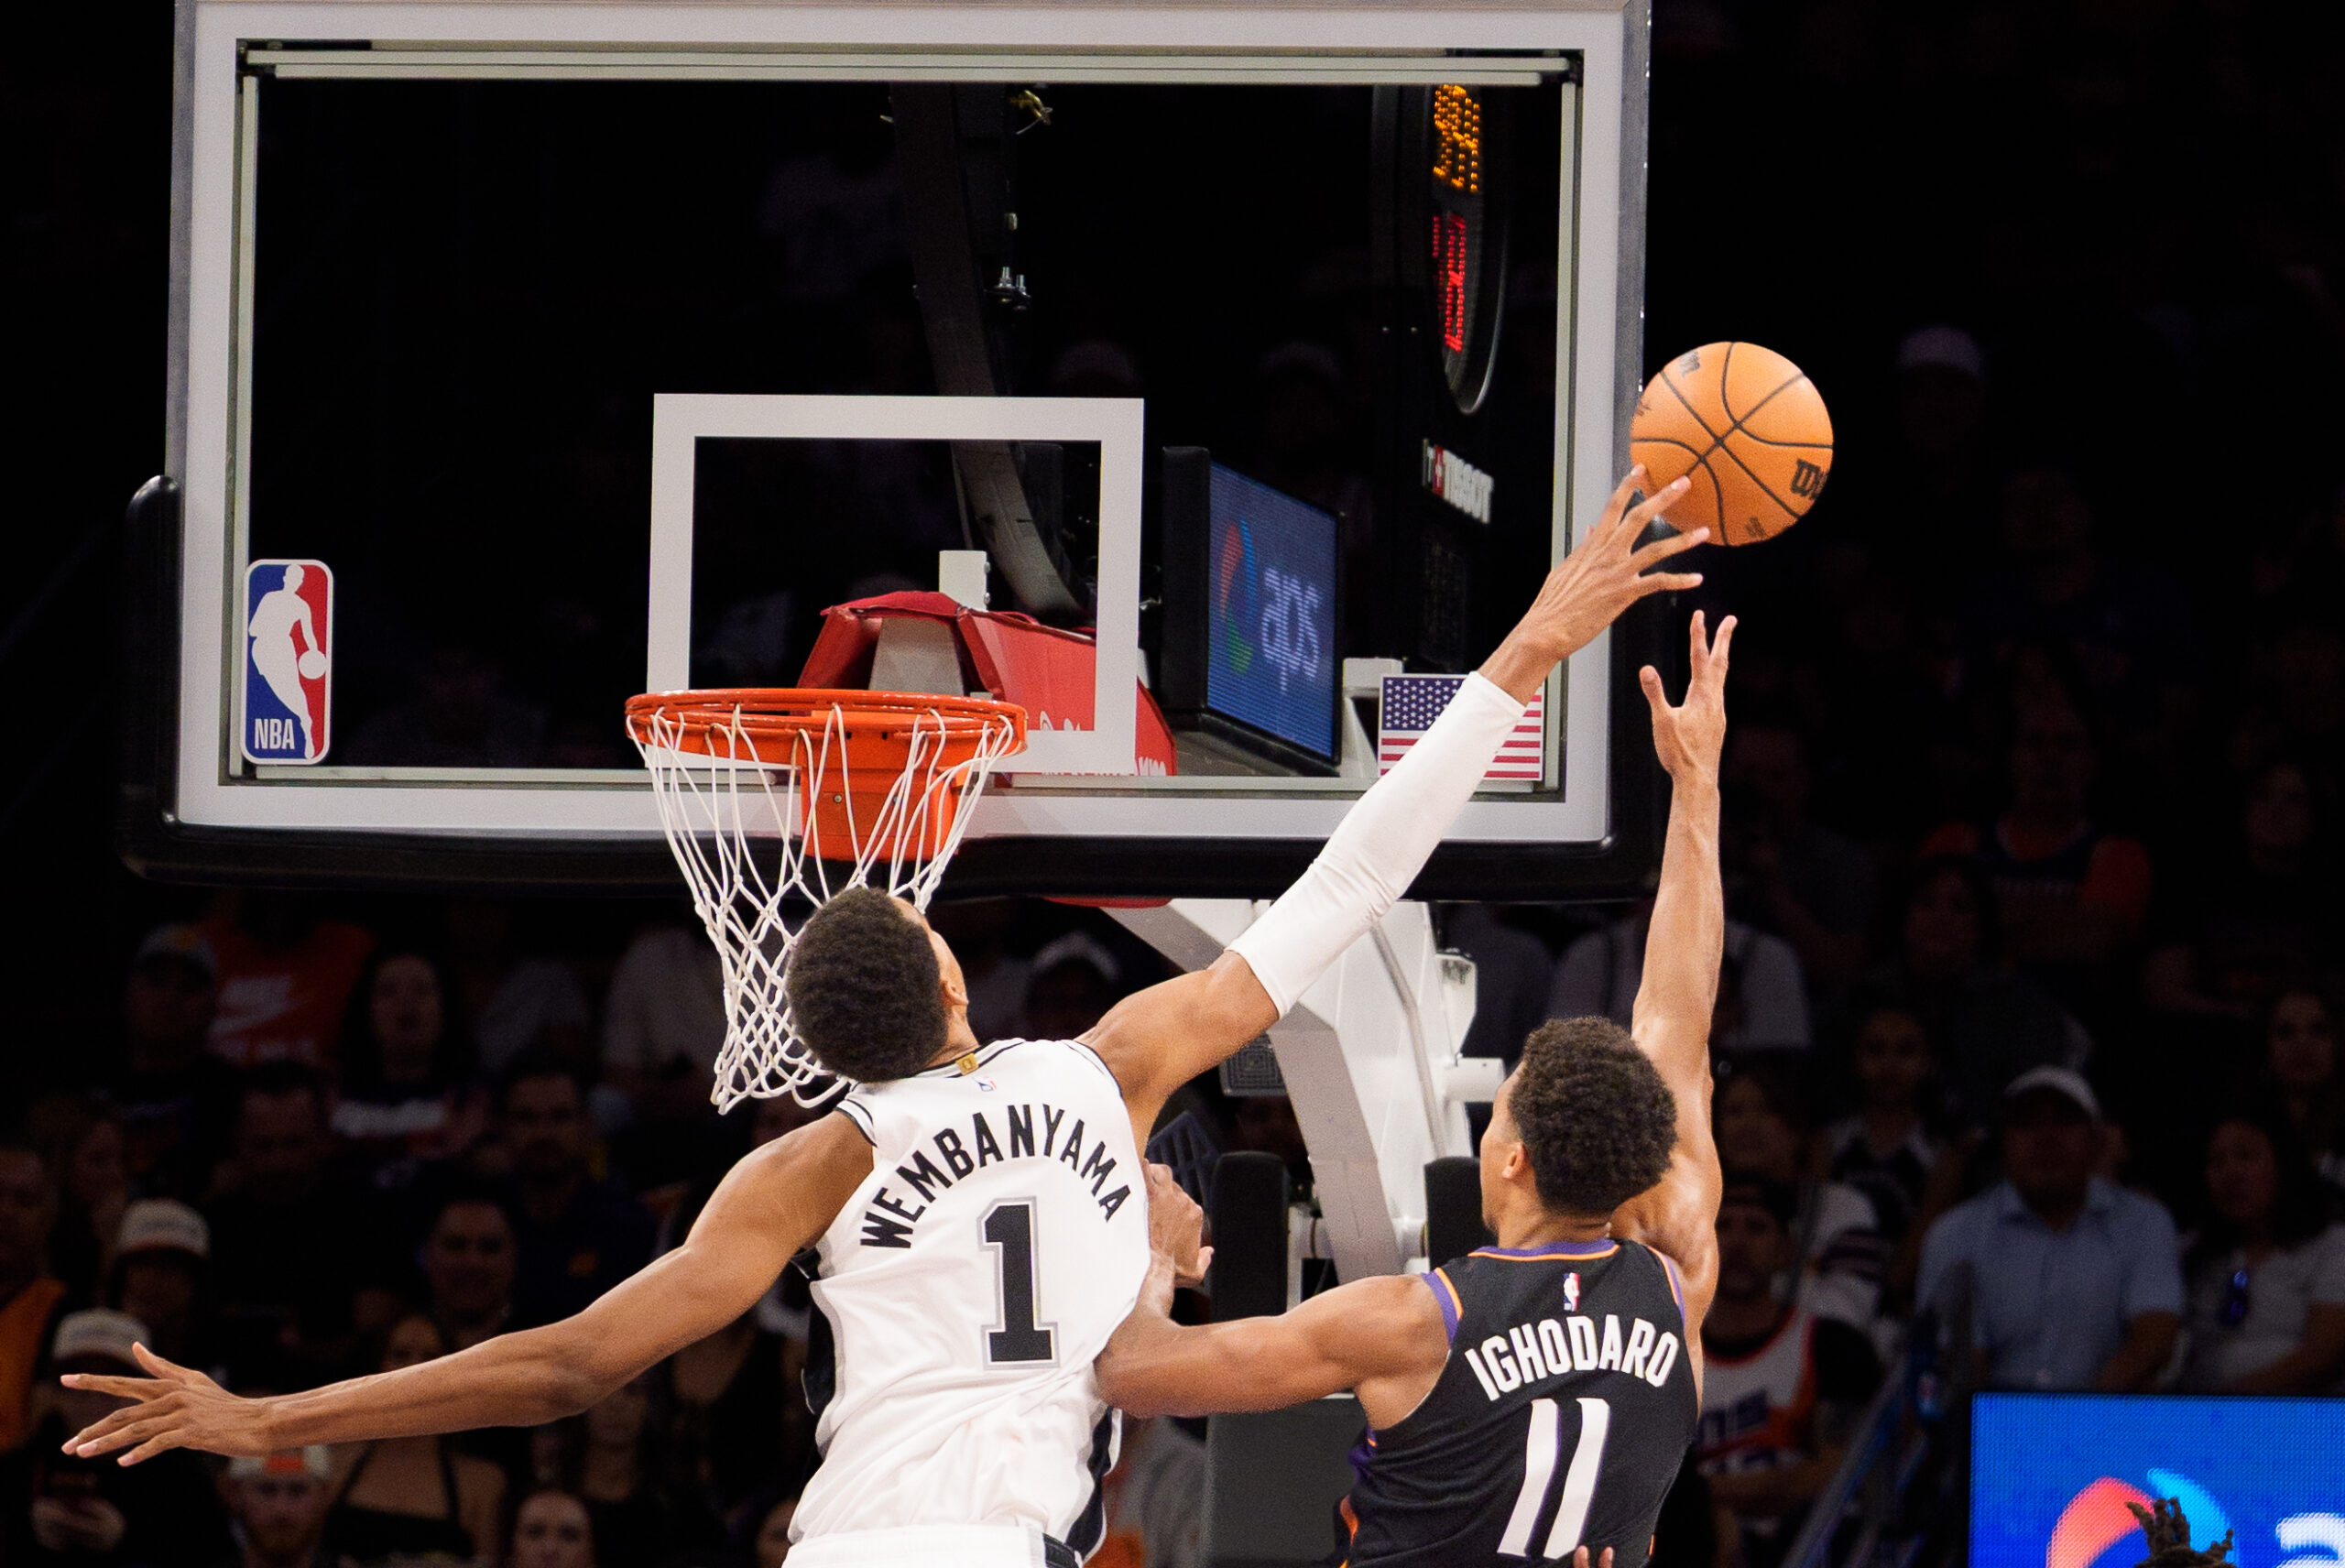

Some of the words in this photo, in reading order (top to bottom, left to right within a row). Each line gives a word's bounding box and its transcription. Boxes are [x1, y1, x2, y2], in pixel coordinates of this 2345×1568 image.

[1261, 566, 1320, 694] aps
[254, 718, 295, 750] NBA
[859, 1103, 1131, 1249] WEMBANYAMA
[977, 1196, 1059, 1370] 1
[1464, 1313, 1679, 1401] IGHODARO
[1497, 1397, 1611, 1561] 11
